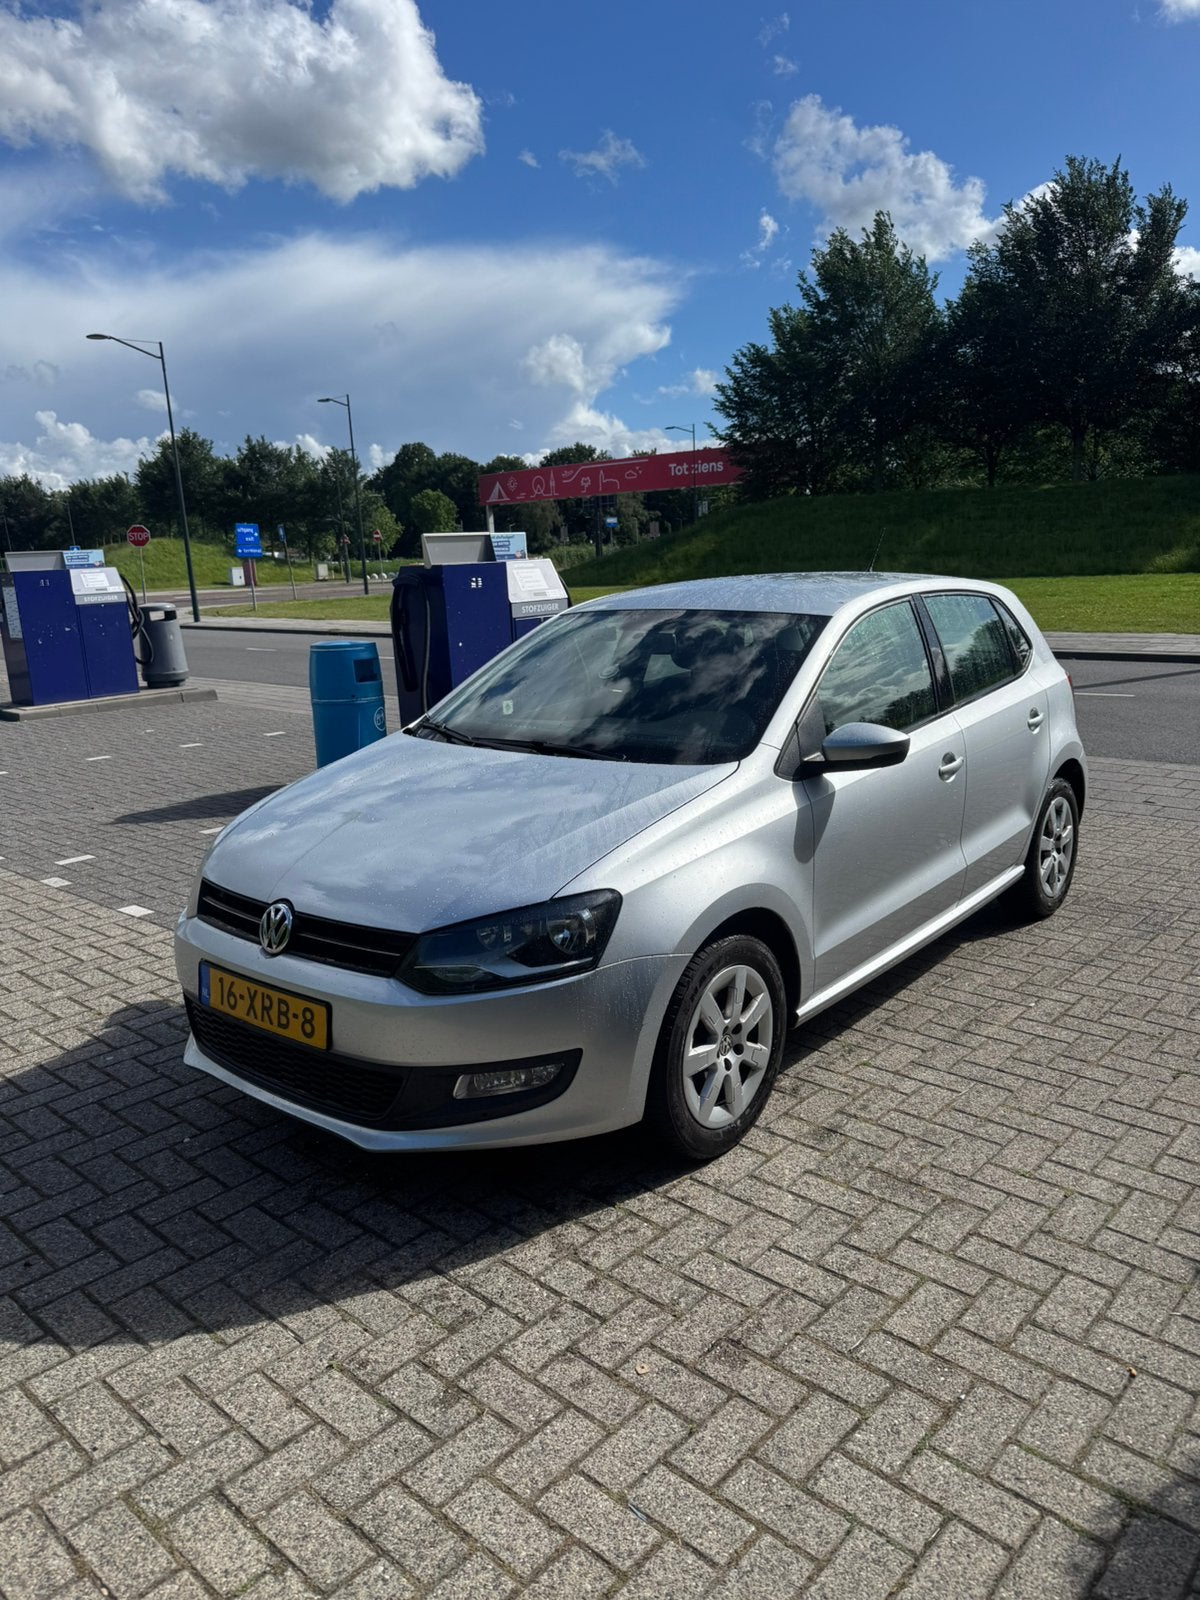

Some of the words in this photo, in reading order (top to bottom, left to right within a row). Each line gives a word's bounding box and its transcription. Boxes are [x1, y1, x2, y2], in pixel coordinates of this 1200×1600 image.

[668, 462, 689, 477] Tot
[691, 460, 724, 474] ziens
[129, 531, 149, 541] STOP
[521, 602, 560, 614] STOFZUIGER
[201, 986, 209, 999] NL
[218, 977, 315, 1039] 16-XRB-8
